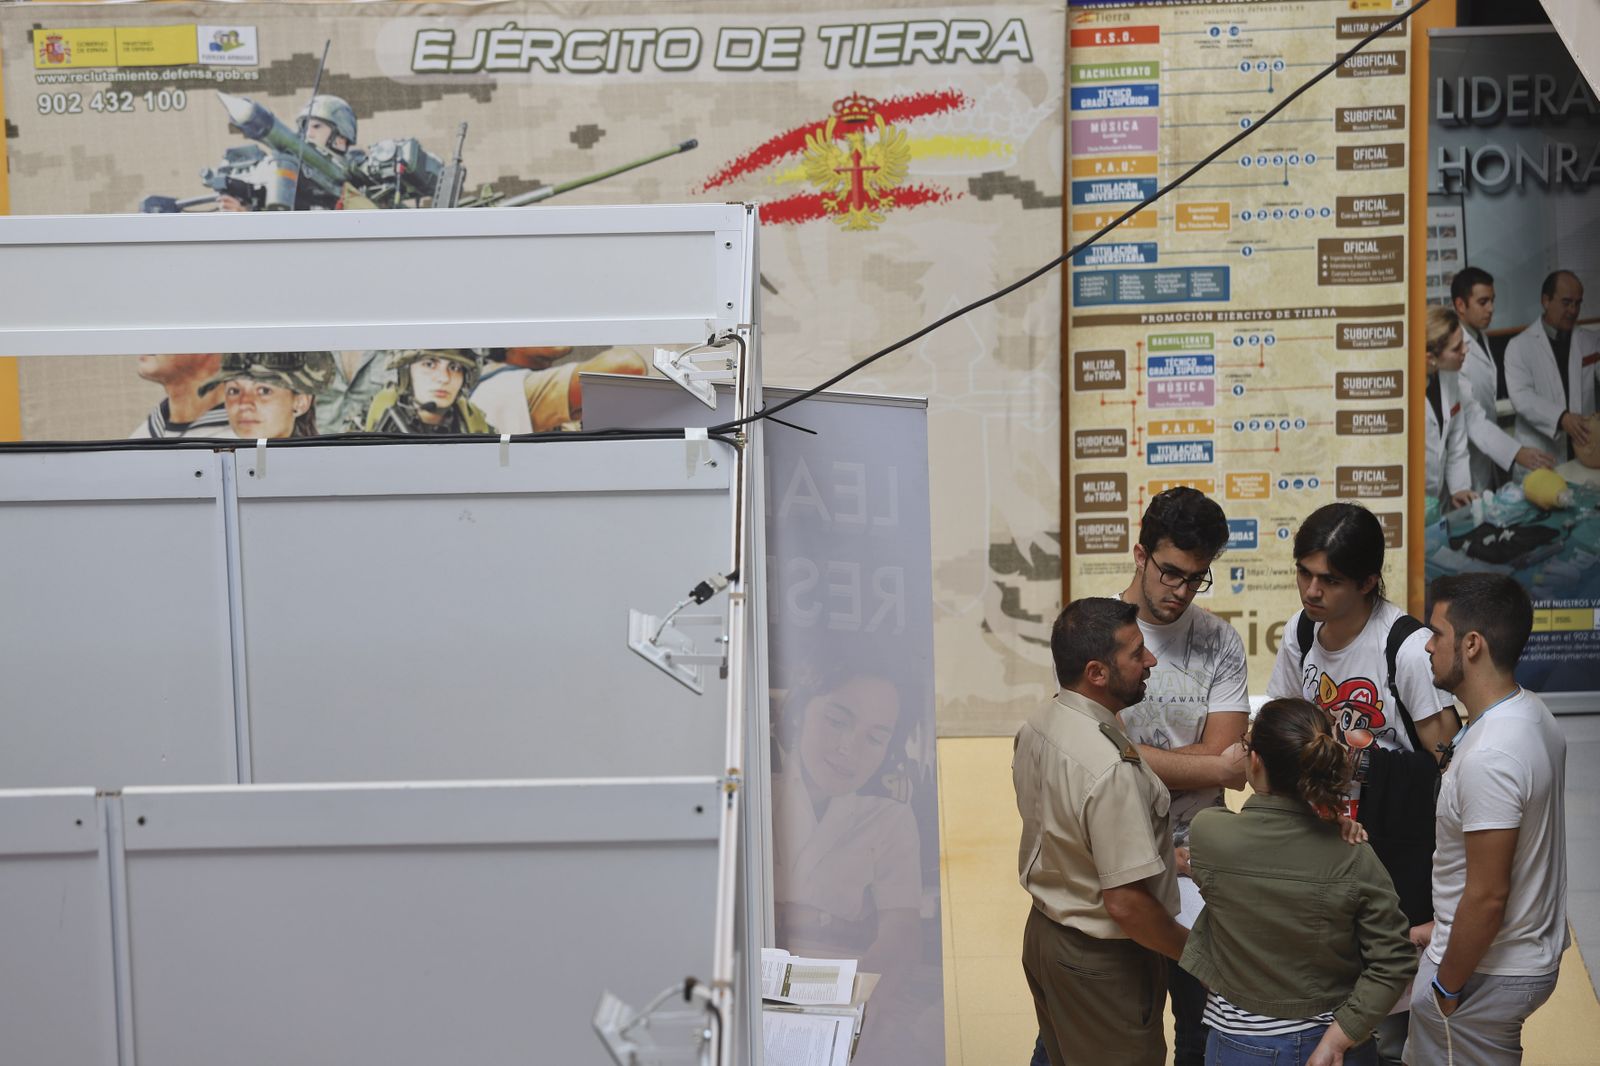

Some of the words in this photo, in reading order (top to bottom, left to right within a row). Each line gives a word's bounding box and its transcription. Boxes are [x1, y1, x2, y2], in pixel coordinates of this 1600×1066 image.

[411, 22, 702, 73] EJÉRCITO
[714, 26, 804, 70] DE
[819, 18, 1034, 69] TIERRA
[1344, 54, 1398, 68] SUBOFICIAL
[36, 68, 259, 84] www.reclutamiento.defensa.gob.es
[1080, 66, 1151, 79] BACHILLERATO
[37, 93, 82, 115] 902
[90, 92, 134, 113] 432
[143, 90, 187, 111] 100
[1343, 108, 1397, 123] SUBOFICIAL
[1353, 147, 1388, 161] OFICIAL
[1353, 199, 1388, 212] OFICIAL
[1344, 241, 1379, 254] OFICIAL
[1141, 312, 1213, 324] PROMOCIÓN
[1276, 310, 1290, 318] DE
[1295, 308, 1337, 318] TIERRA
[1343, 326, 1397, 340] SUBOFICIAL
[1343, 376, 1397, 390] SUBOFICIAL
[1352, 414, 1388, 426] OFICIAL
[1077, 435, 1125, 448] SUBOFICIAL
[1352, 470, 1388, 482] OFICIAL
